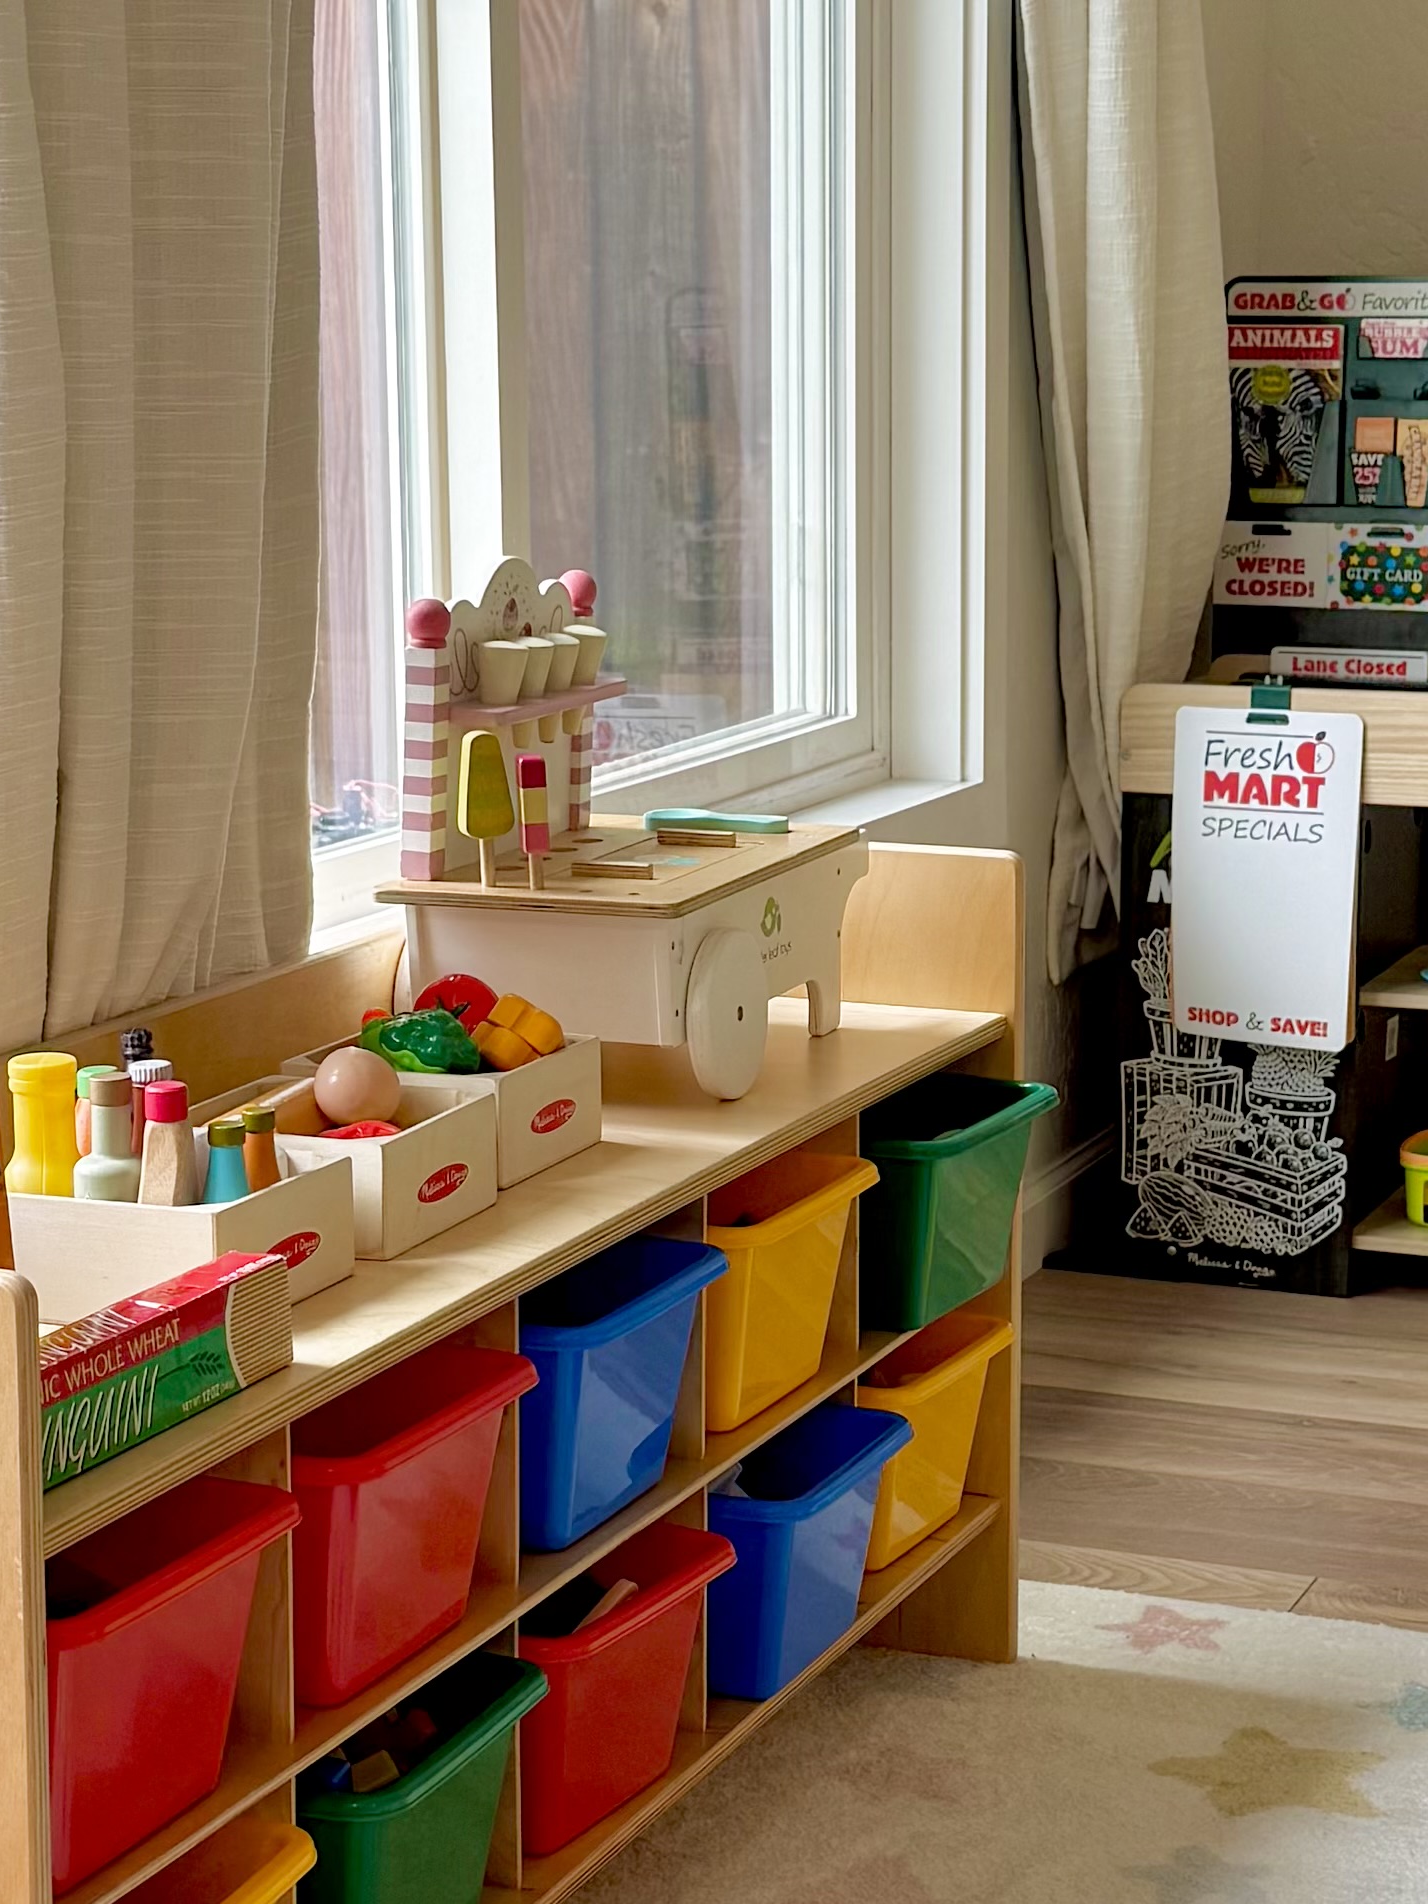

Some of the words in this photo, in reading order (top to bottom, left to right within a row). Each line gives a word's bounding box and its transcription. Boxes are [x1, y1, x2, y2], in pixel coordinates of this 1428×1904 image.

[1230, 328, 1335, 348] ANIMALS
[1236, 557, 1305, 575] WE'RE
[1346, 567, 1381, 581] GIFT
[1385, 569, 1423, 582] CARD
[1225, 579, 1315, 598] CLOSED!
[1291, 656, 1337, 674] Lane
[1344, 659, 1407, 676] Closed
[1204, 739, 1295, 771] Fresh
[1203, 770, 1325, 809] MART
[1201, 816, 1324, 844] SPECIALS
[1187, 1007, 1239, 1027] SHOP
[1245, 1012, 1263, 1032] &
[1270, 1017, 1329, 1038] SAVE!
[64, 1345, 125, 1392] WHOLE
[127, 1318, 181, 1362] WHEAT
[42, 1364, 159, 1481] INGUINI
